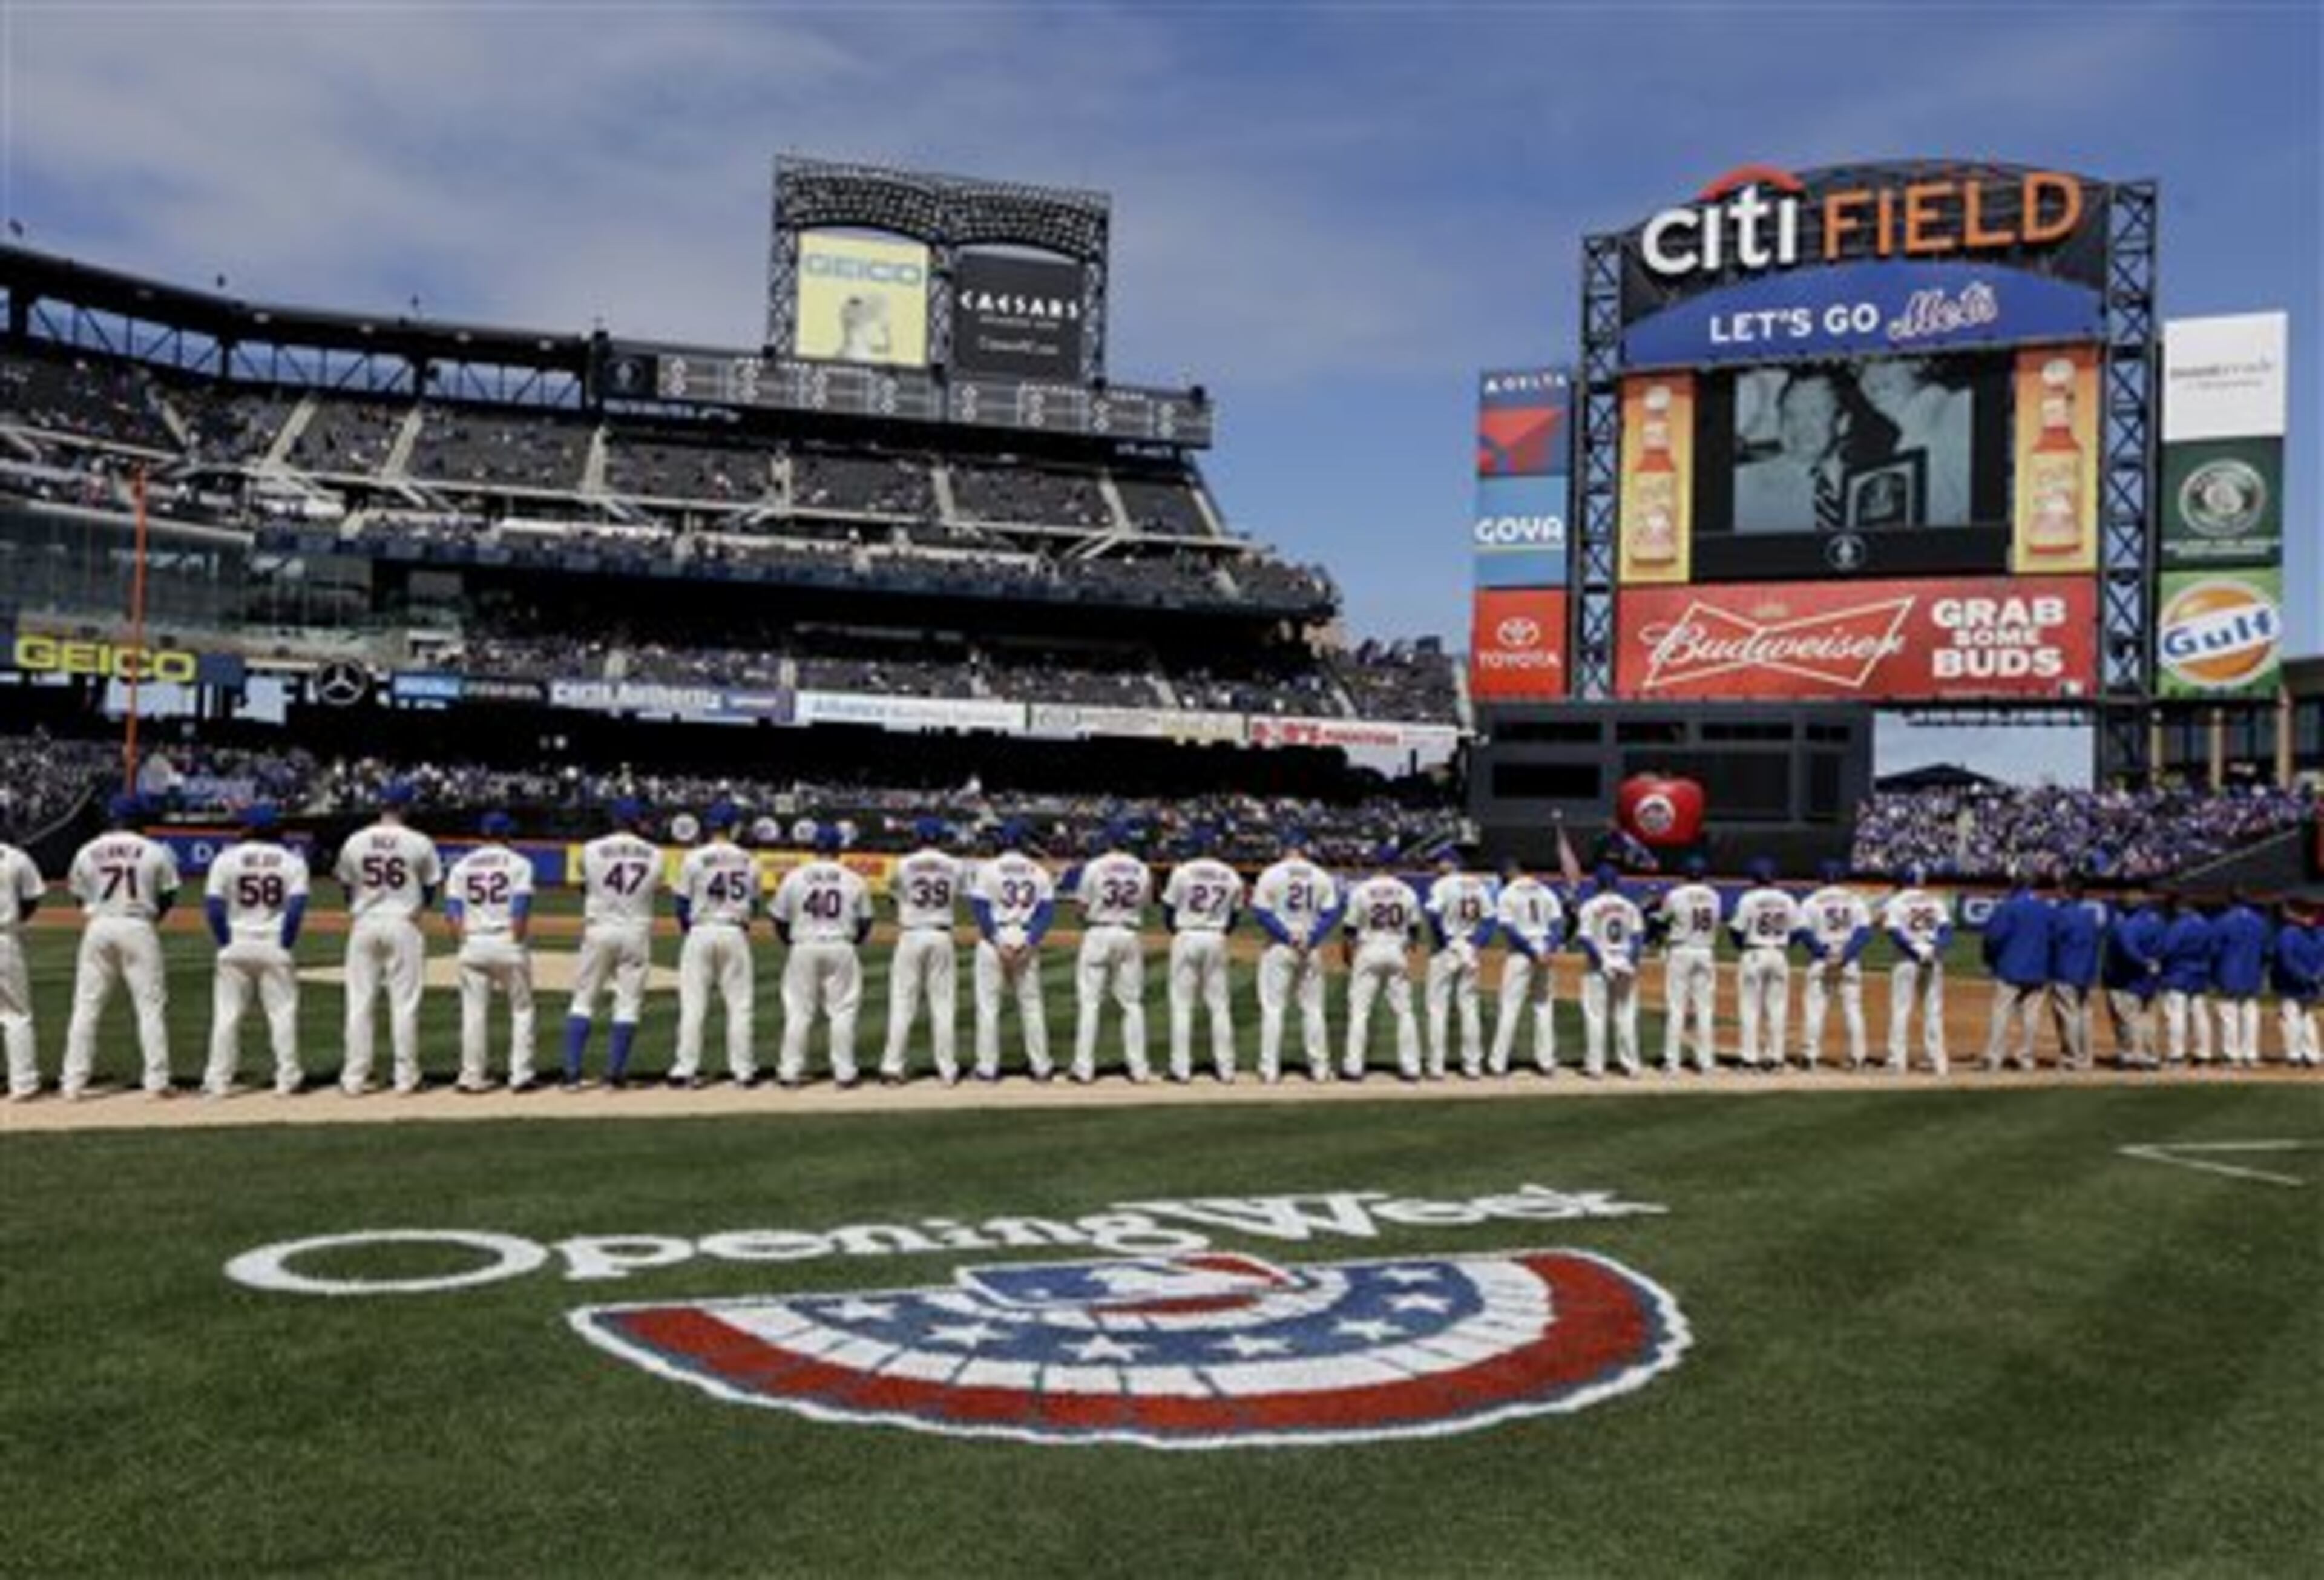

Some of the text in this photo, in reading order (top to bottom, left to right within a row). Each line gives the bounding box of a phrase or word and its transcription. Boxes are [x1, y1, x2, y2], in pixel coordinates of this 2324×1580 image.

[1641, 171, 2082, 275] citi FIELD
[804, 252, 923, 286] GEICO
[960, 289, 1078, 321] CAESARS
[1710, 306, 1812, 343] LET'S
[1823, 303, 1879, 335] GO
[1474, 516, 1564, 542] GOYA
[1931, 596, 2065, 628] GRAB
[1639, 621, 1905, 665] Budweiser
[1953, 628, 2042, 647] SOME
[2164, 605, 2274, 660] Gulf
[13, 635, 197, 683] GEICO
[1478, 651, 1561, 668] TOYOTA
[1932, 647, 2064, 679] BUDS
[100, 866, 140, 900] 71
[362, 857, 406, 889] 56
[466, 871, 509, 905] 52
[603, 862, 649, 895] 47
[706, 870, 746, 901] 45
[237, 875, 284, 907] 58
[802, 888, 842, 919] 40
[911, 879, 951, 908] 39
[1001, 880, 1036, 908] 33
[1101, 879, 1140, 907] 32
[1187, 884, 1227, 913] 27
[1287, 883, 1313, 912] 21
[1370, 902, 1405, 930] 20
[222, 1184, 1672, 1294] Opening Week
